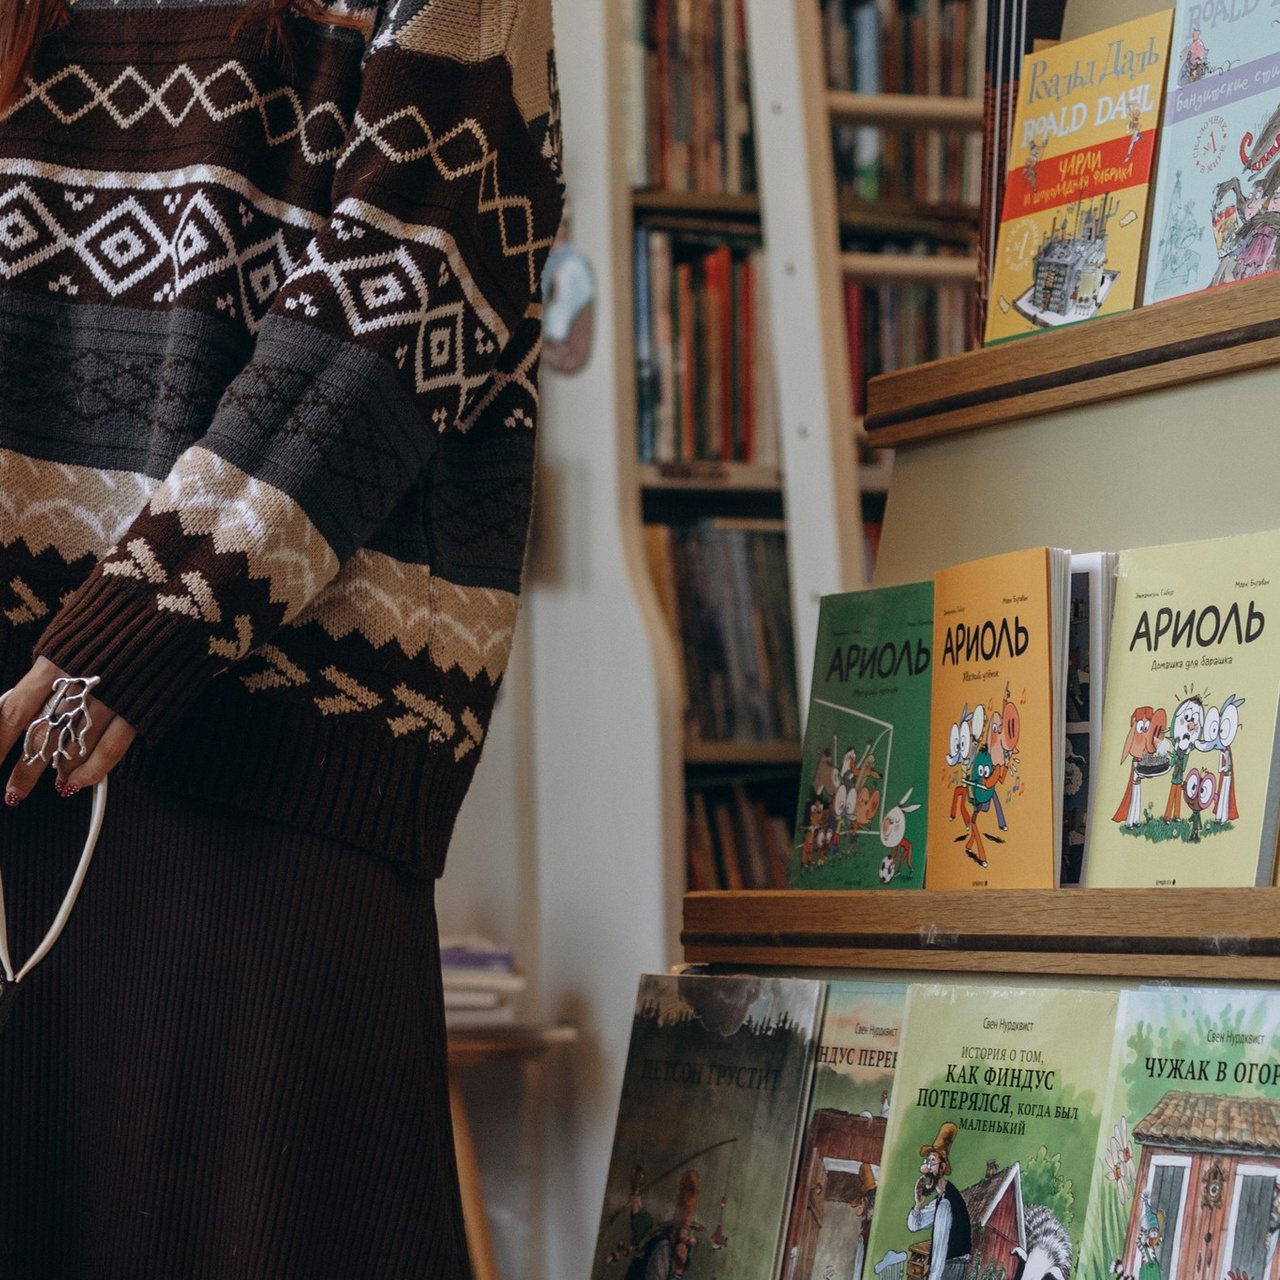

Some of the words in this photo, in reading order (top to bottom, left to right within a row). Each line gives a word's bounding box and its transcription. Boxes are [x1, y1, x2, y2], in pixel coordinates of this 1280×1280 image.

[1029, 60, 1095, 104] Роальд
[1099, 36, 1159, 84] Даль
[1021, 103, 1087, 147] ROALD
[1094, 84, 1155, 126] DAHL
[1059, 151, 1102, 180] ЧАРЛИ
[1093, 162, 1133, 187] ФАБРИКА
[1129, 600, 1265, 652] АРИОЛЬ
[942, 615, 1029, 666] АРИОЛЬ
[825, 638, 931, 683] АРИОЛЬ
[1151, 659, 1183, 671] Домашка
[1185, 658, 1199, 671] для
[1200, 655, 1233, 667] барашка
[983, 1017, 998, 1030] Свен
[999, 1018, 1034, 1033] Нурдквист
[1206, 1029, 1224, 1043] Свен
[1225, 1030, 1265, 1047] Нурдквист
[961, 1046, 1007, 1061] ИСТОРИЯ
[1009, 1049, 1017, 1062] О
[1020, 1050, 1044, 1065] ТОМ,
[1145, 1057, 1210, 1081] ЧУЖАК
[1215, 1061, 1228, 1082] В
[945, 1064, 980, 1085] КАК
[984, 1067, 1055, 1092] ФИНДУС
[916, 1088, 1014, 1117] ПОТЕРЯЛСЯ,
[1017, 1103, 1051, 1118] КОГДА
[1054, 1106, 1079, 1120] БЫЛ
[958, 1118, 1026, 1135] МАЛЕНЬКИЙ
